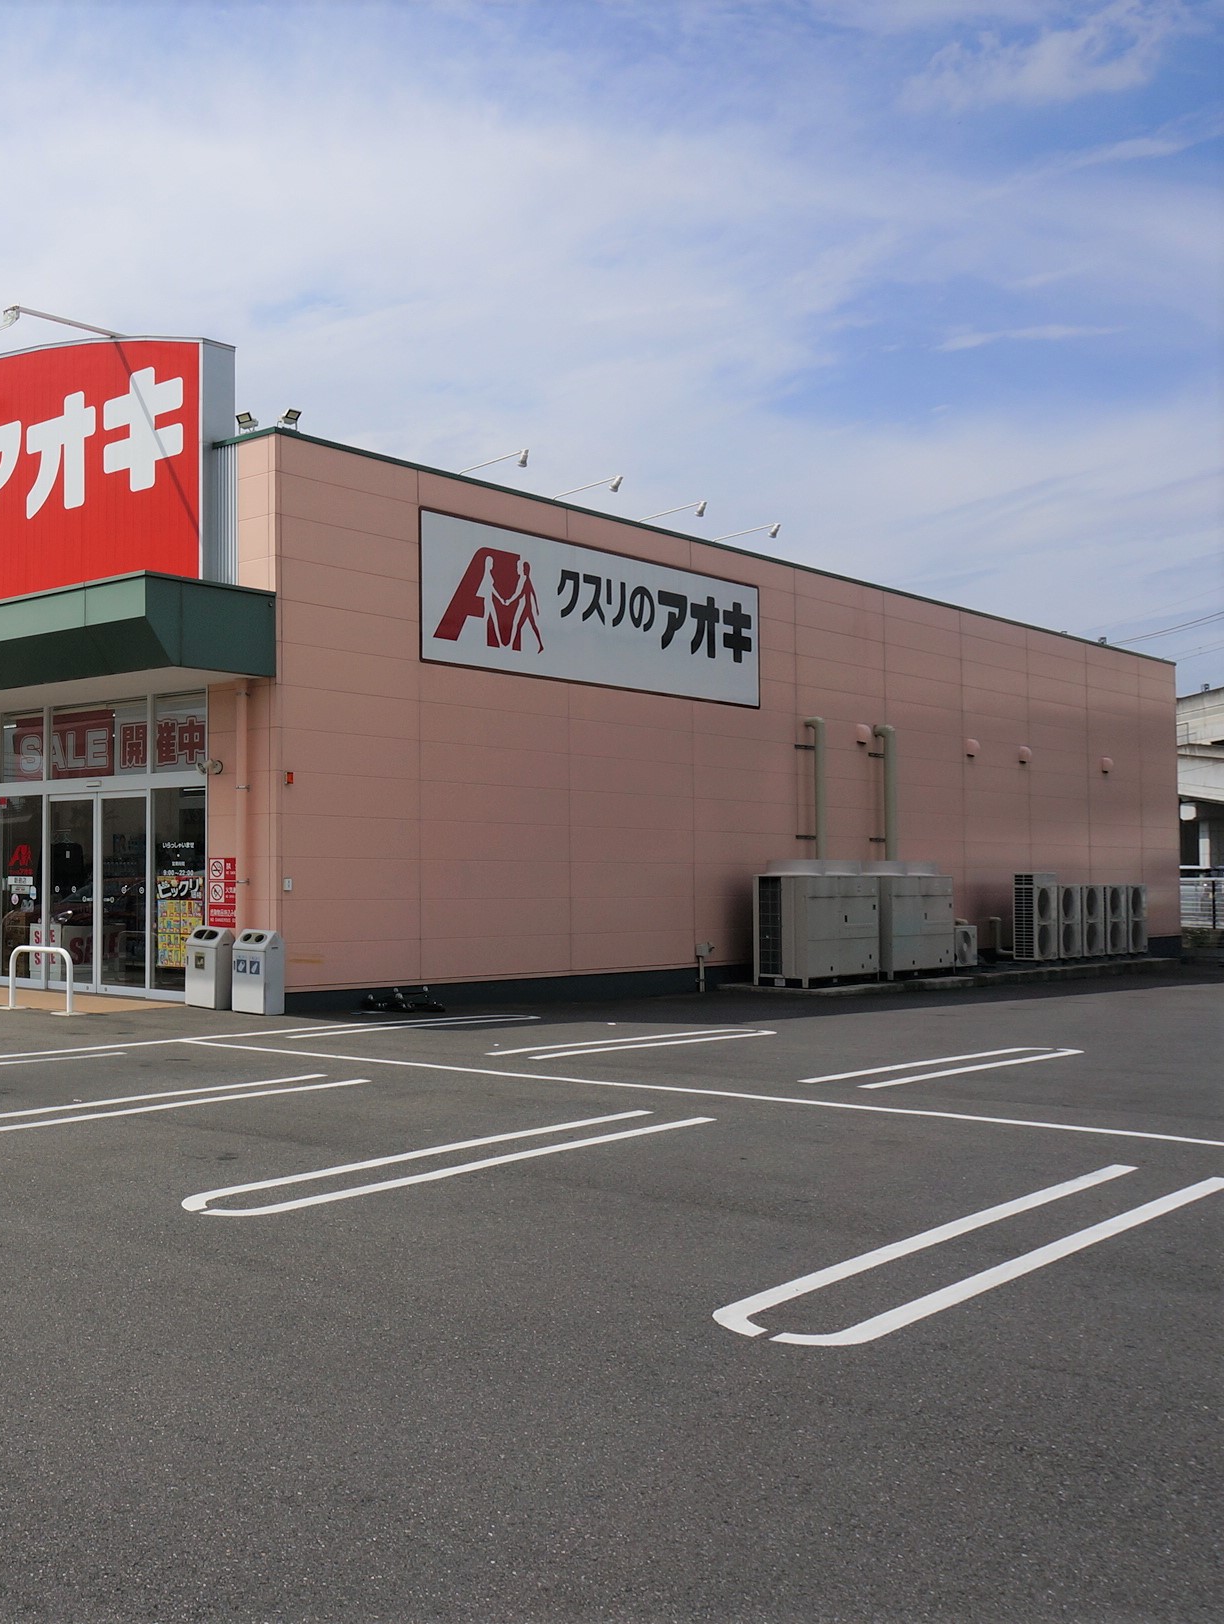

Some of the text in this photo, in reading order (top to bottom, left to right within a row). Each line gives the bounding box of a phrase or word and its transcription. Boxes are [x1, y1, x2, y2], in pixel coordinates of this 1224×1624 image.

[557, 568, 753, 664] クスリのアオキ
[19, 727, 110, 774] SALE
[119, 715, 207, 769] 開催中
